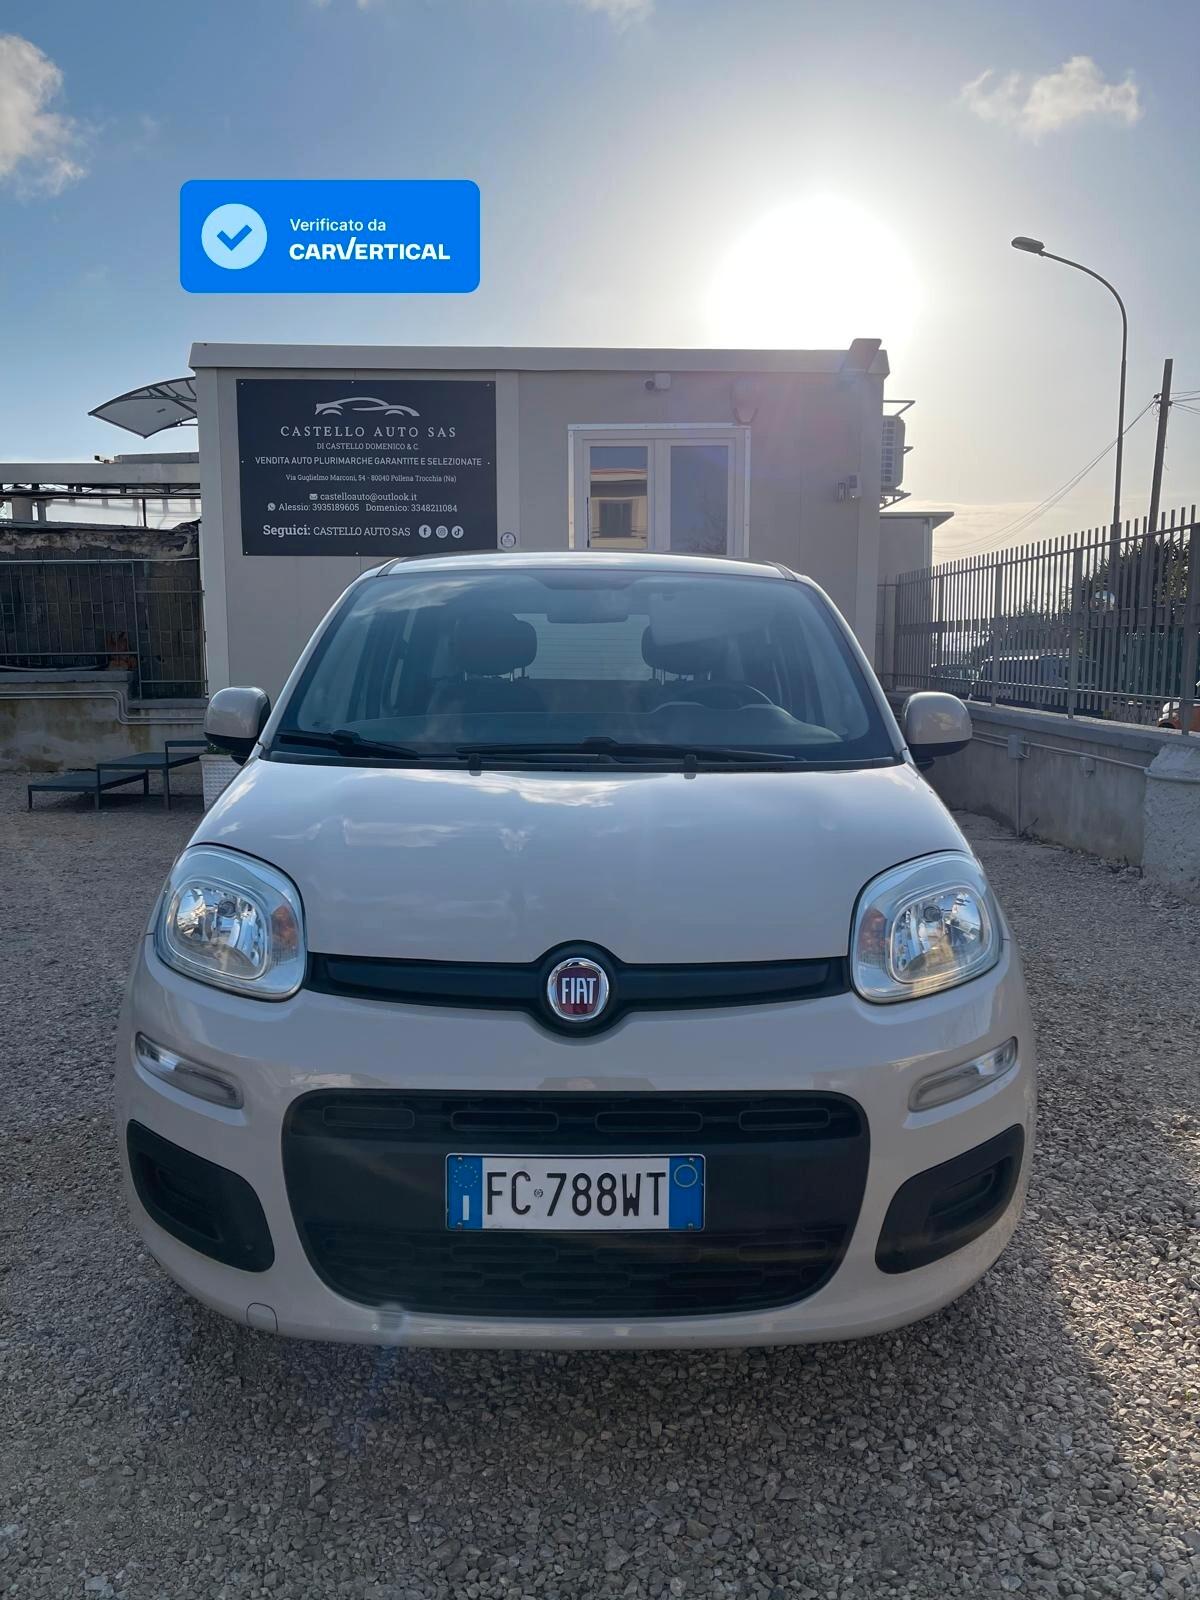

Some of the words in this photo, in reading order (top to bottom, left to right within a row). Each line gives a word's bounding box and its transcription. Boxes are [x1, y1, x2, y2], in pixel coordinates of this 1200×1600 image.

[280, 426, 365, 437] CASTELLO
[374, 426, 419, 438] AUTO
[428, 427, 456, 438] SAS
[316, 442, 325, 450] DI
[325, 442, 364, 450] CASTELLO
[255, 456, 290, 465] VENDITA
[291, 456, 313, 465] AUTO
[314, 456, 373, 465] PLURIMARCHE
[374, 457, 419, 465] GARANTITE
[421, 457, 426, 465] E
[427, 457, 482, 466] SELEZIONATE
[297, 474, 329, 482] Guglielmo
[443, 475, 457, 483] (Na)
[320, 492, 417, 502] castelloauto@outlook.it
[279, 503, 311, 511] Alessio:
[312, 503, 360, 511] 3935189605
[366, 504, 410, 512] Domenico:
[411, 504, 457, 512] 3348211084
[263, 524, 311, 538] Seguici:
[313, 526, 362, 536] CASTELLO
[364, 527, 391, 536] AUTO
[392, 527, 411, 537] SAS
[561, 977, 596, 1004] FIAT
